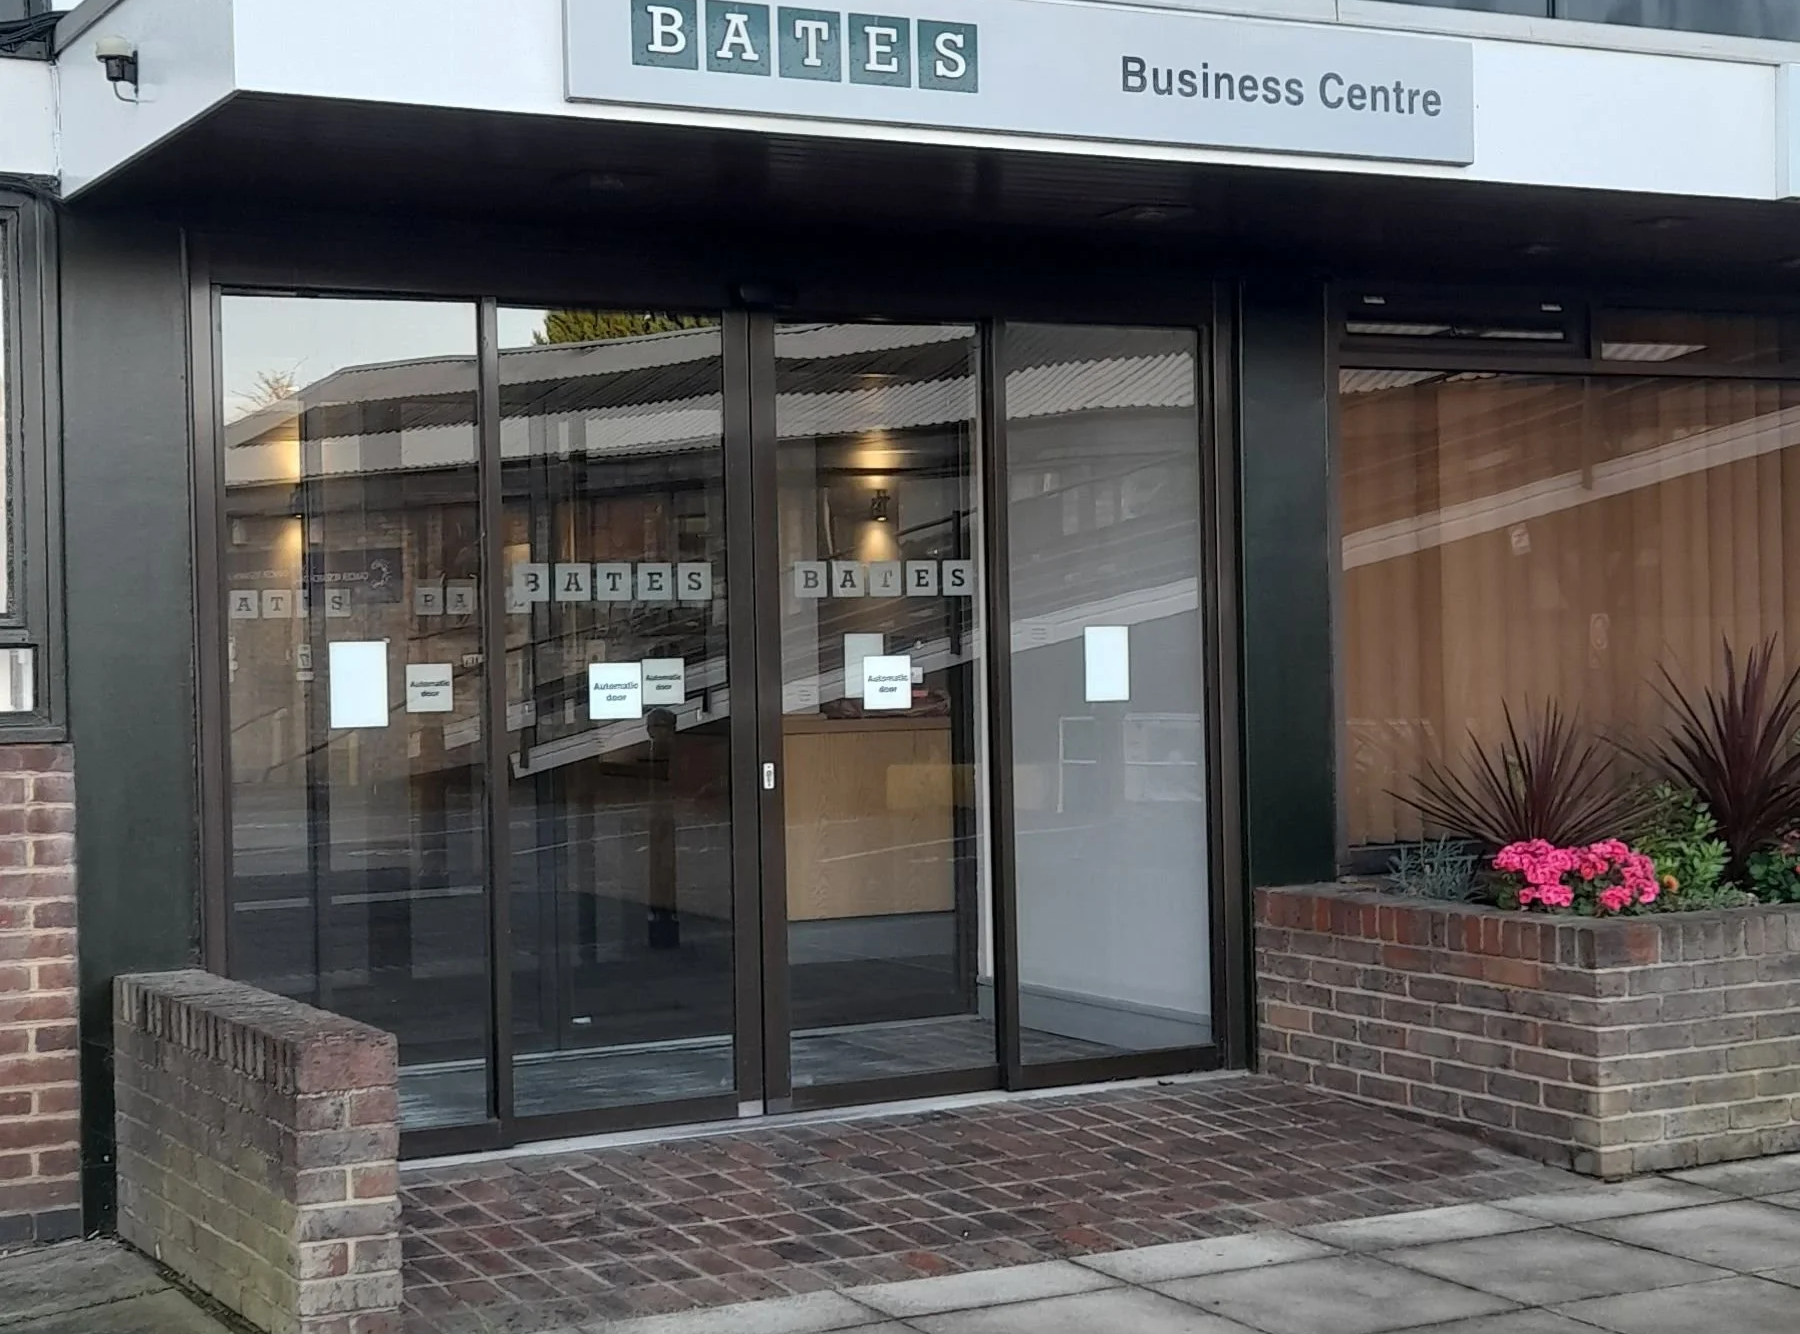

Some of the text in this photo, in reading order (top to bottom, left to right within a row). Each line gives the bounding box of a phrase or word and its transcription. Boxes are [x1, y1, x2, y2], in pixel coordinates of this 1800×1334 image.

[645, 4, 967, 79] BATES
[1121, 55, 1442, 117] Business Centre
[524, 571, 702, 593] BATES
[802, 568, 966, 589] BATES
[593, 680, 639, 690] Automatic
[606, 693, 627, 701] door
